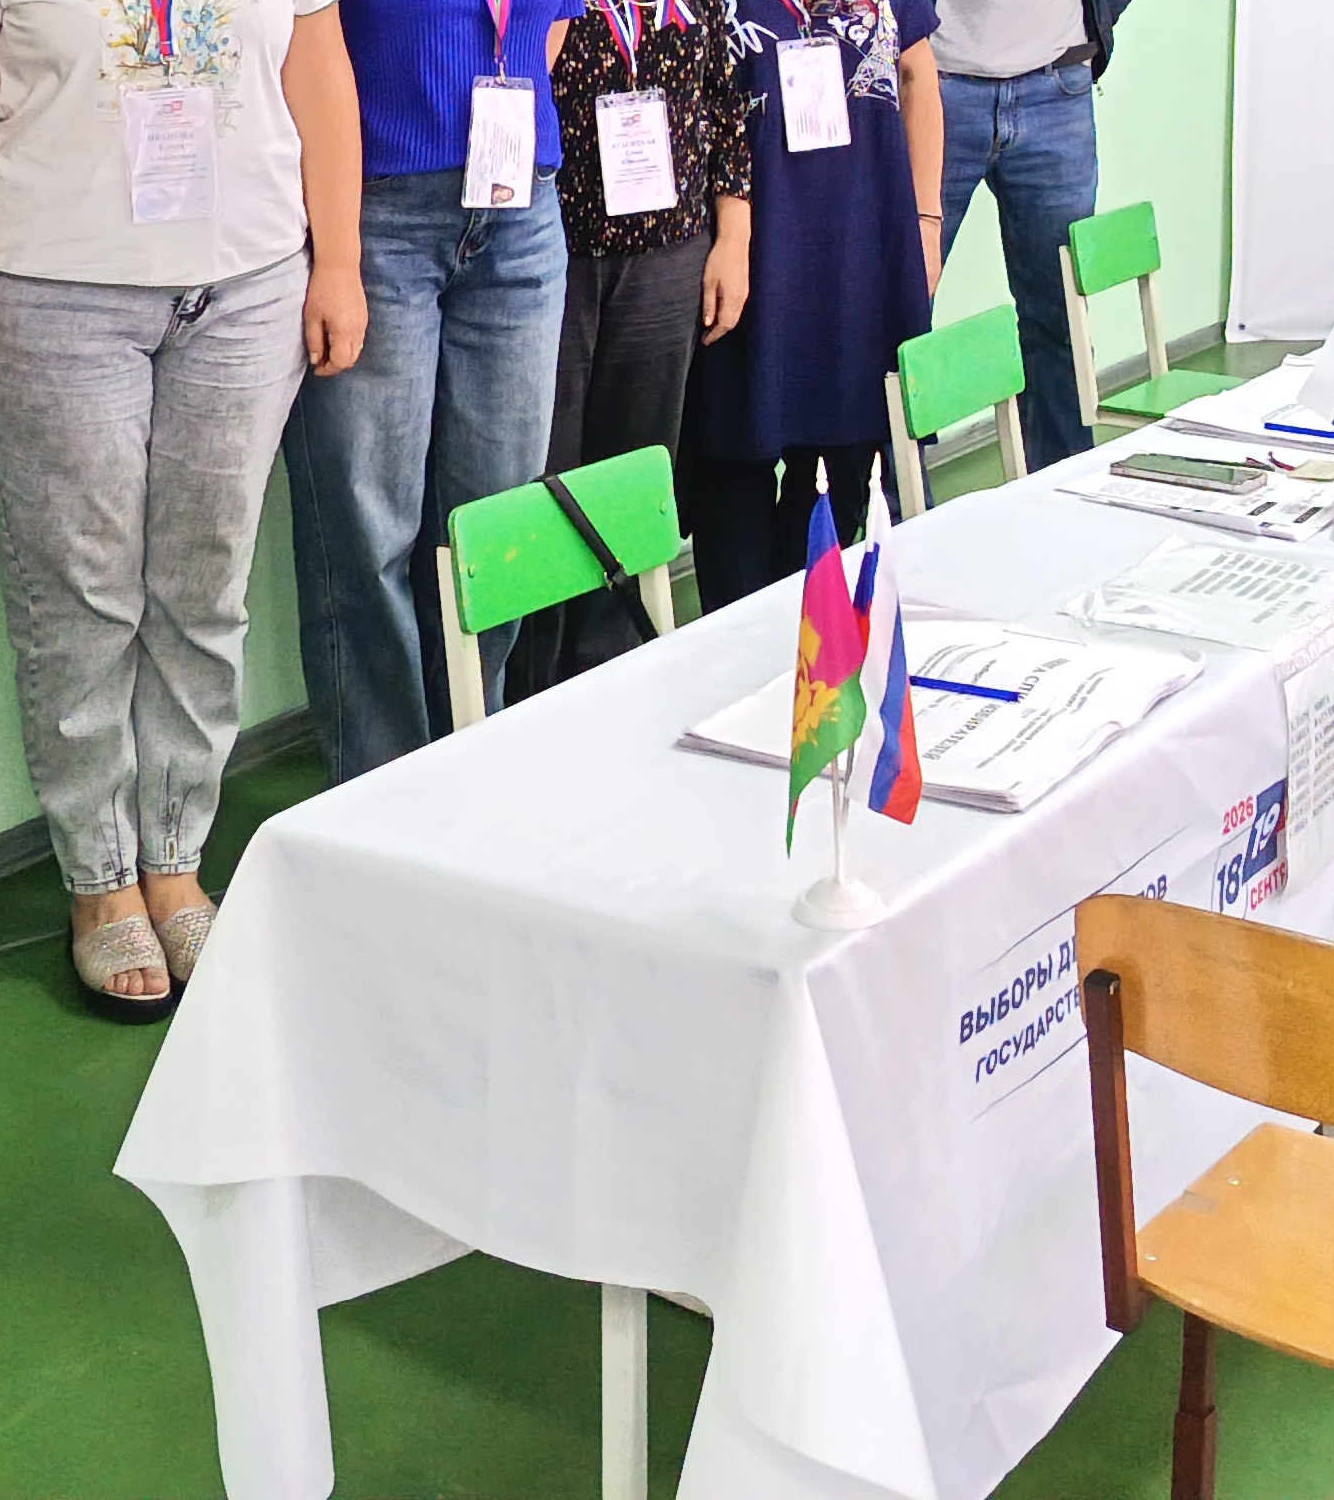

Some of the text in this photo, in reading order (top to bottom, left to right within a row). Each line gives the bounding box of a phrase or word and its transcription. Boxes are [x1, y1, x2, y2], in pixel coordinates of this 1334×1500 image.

[1222, 794, 1255, 836] 2026
[1251, 802, 1281, 861] 19
[1217, 853, 1244, 913] 18
[1250, 861, 1287, 911] СЕНТ
[959, 953, 1053, 1046] ВЫБОРЫ
[975, 983, 1081, 1083] ГОСУДАРСТВ
